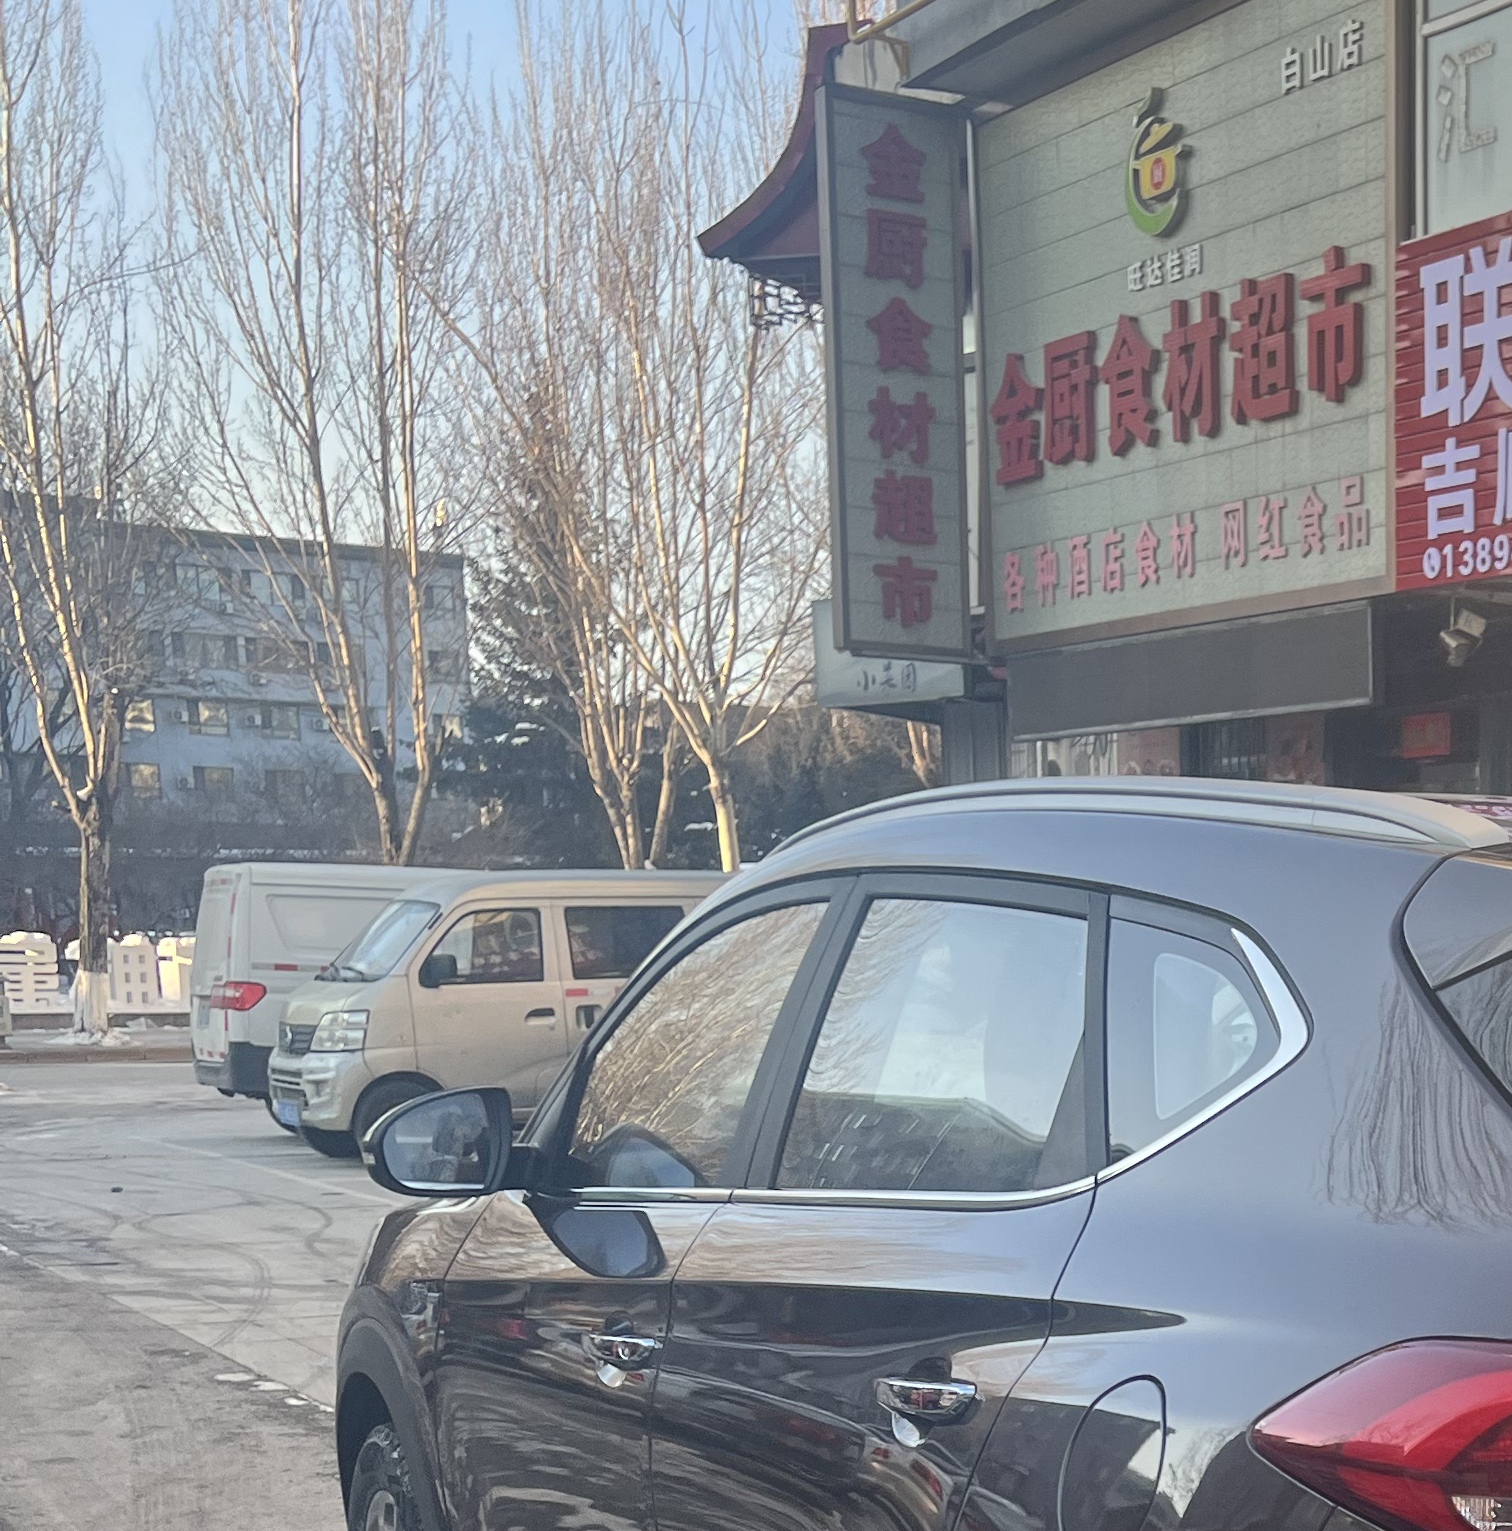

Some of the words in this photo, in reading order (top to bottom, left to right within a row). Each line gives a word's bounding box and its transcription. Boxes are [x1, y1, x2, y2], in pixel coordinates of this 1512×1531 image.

[1281, 19, 1363, 95] 白山店
[860, 121, 938, 627] 金厨食材超市
[991, 246, 1371, 487] 金厨食材超市
[1003, 513, 1197, 614] 各种酒店食材
[1220, 475, 1371, 568] 网红食品
